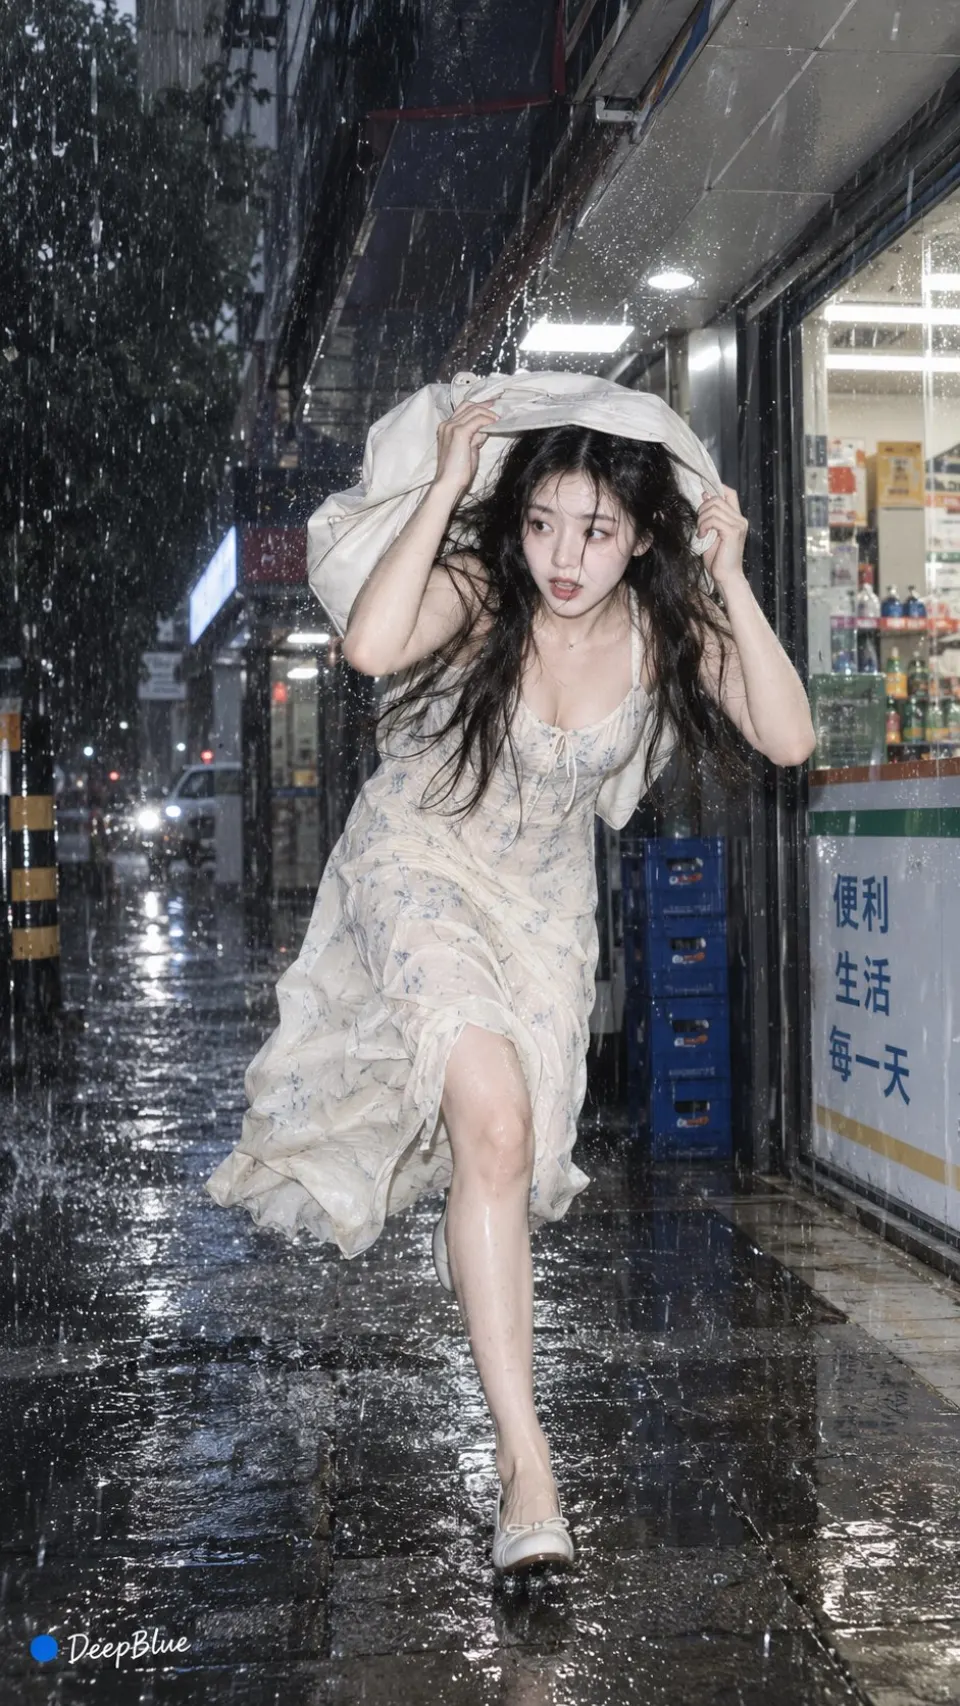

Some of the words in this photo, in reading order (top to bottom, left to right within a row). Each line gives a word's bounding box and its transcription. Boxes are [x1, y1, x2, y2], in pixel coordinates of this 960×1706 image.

[834, 874, 889, 933] 便利
[835, 951, 891, 1016] 生活
[829, 1026, 910, 1106] 每一天
